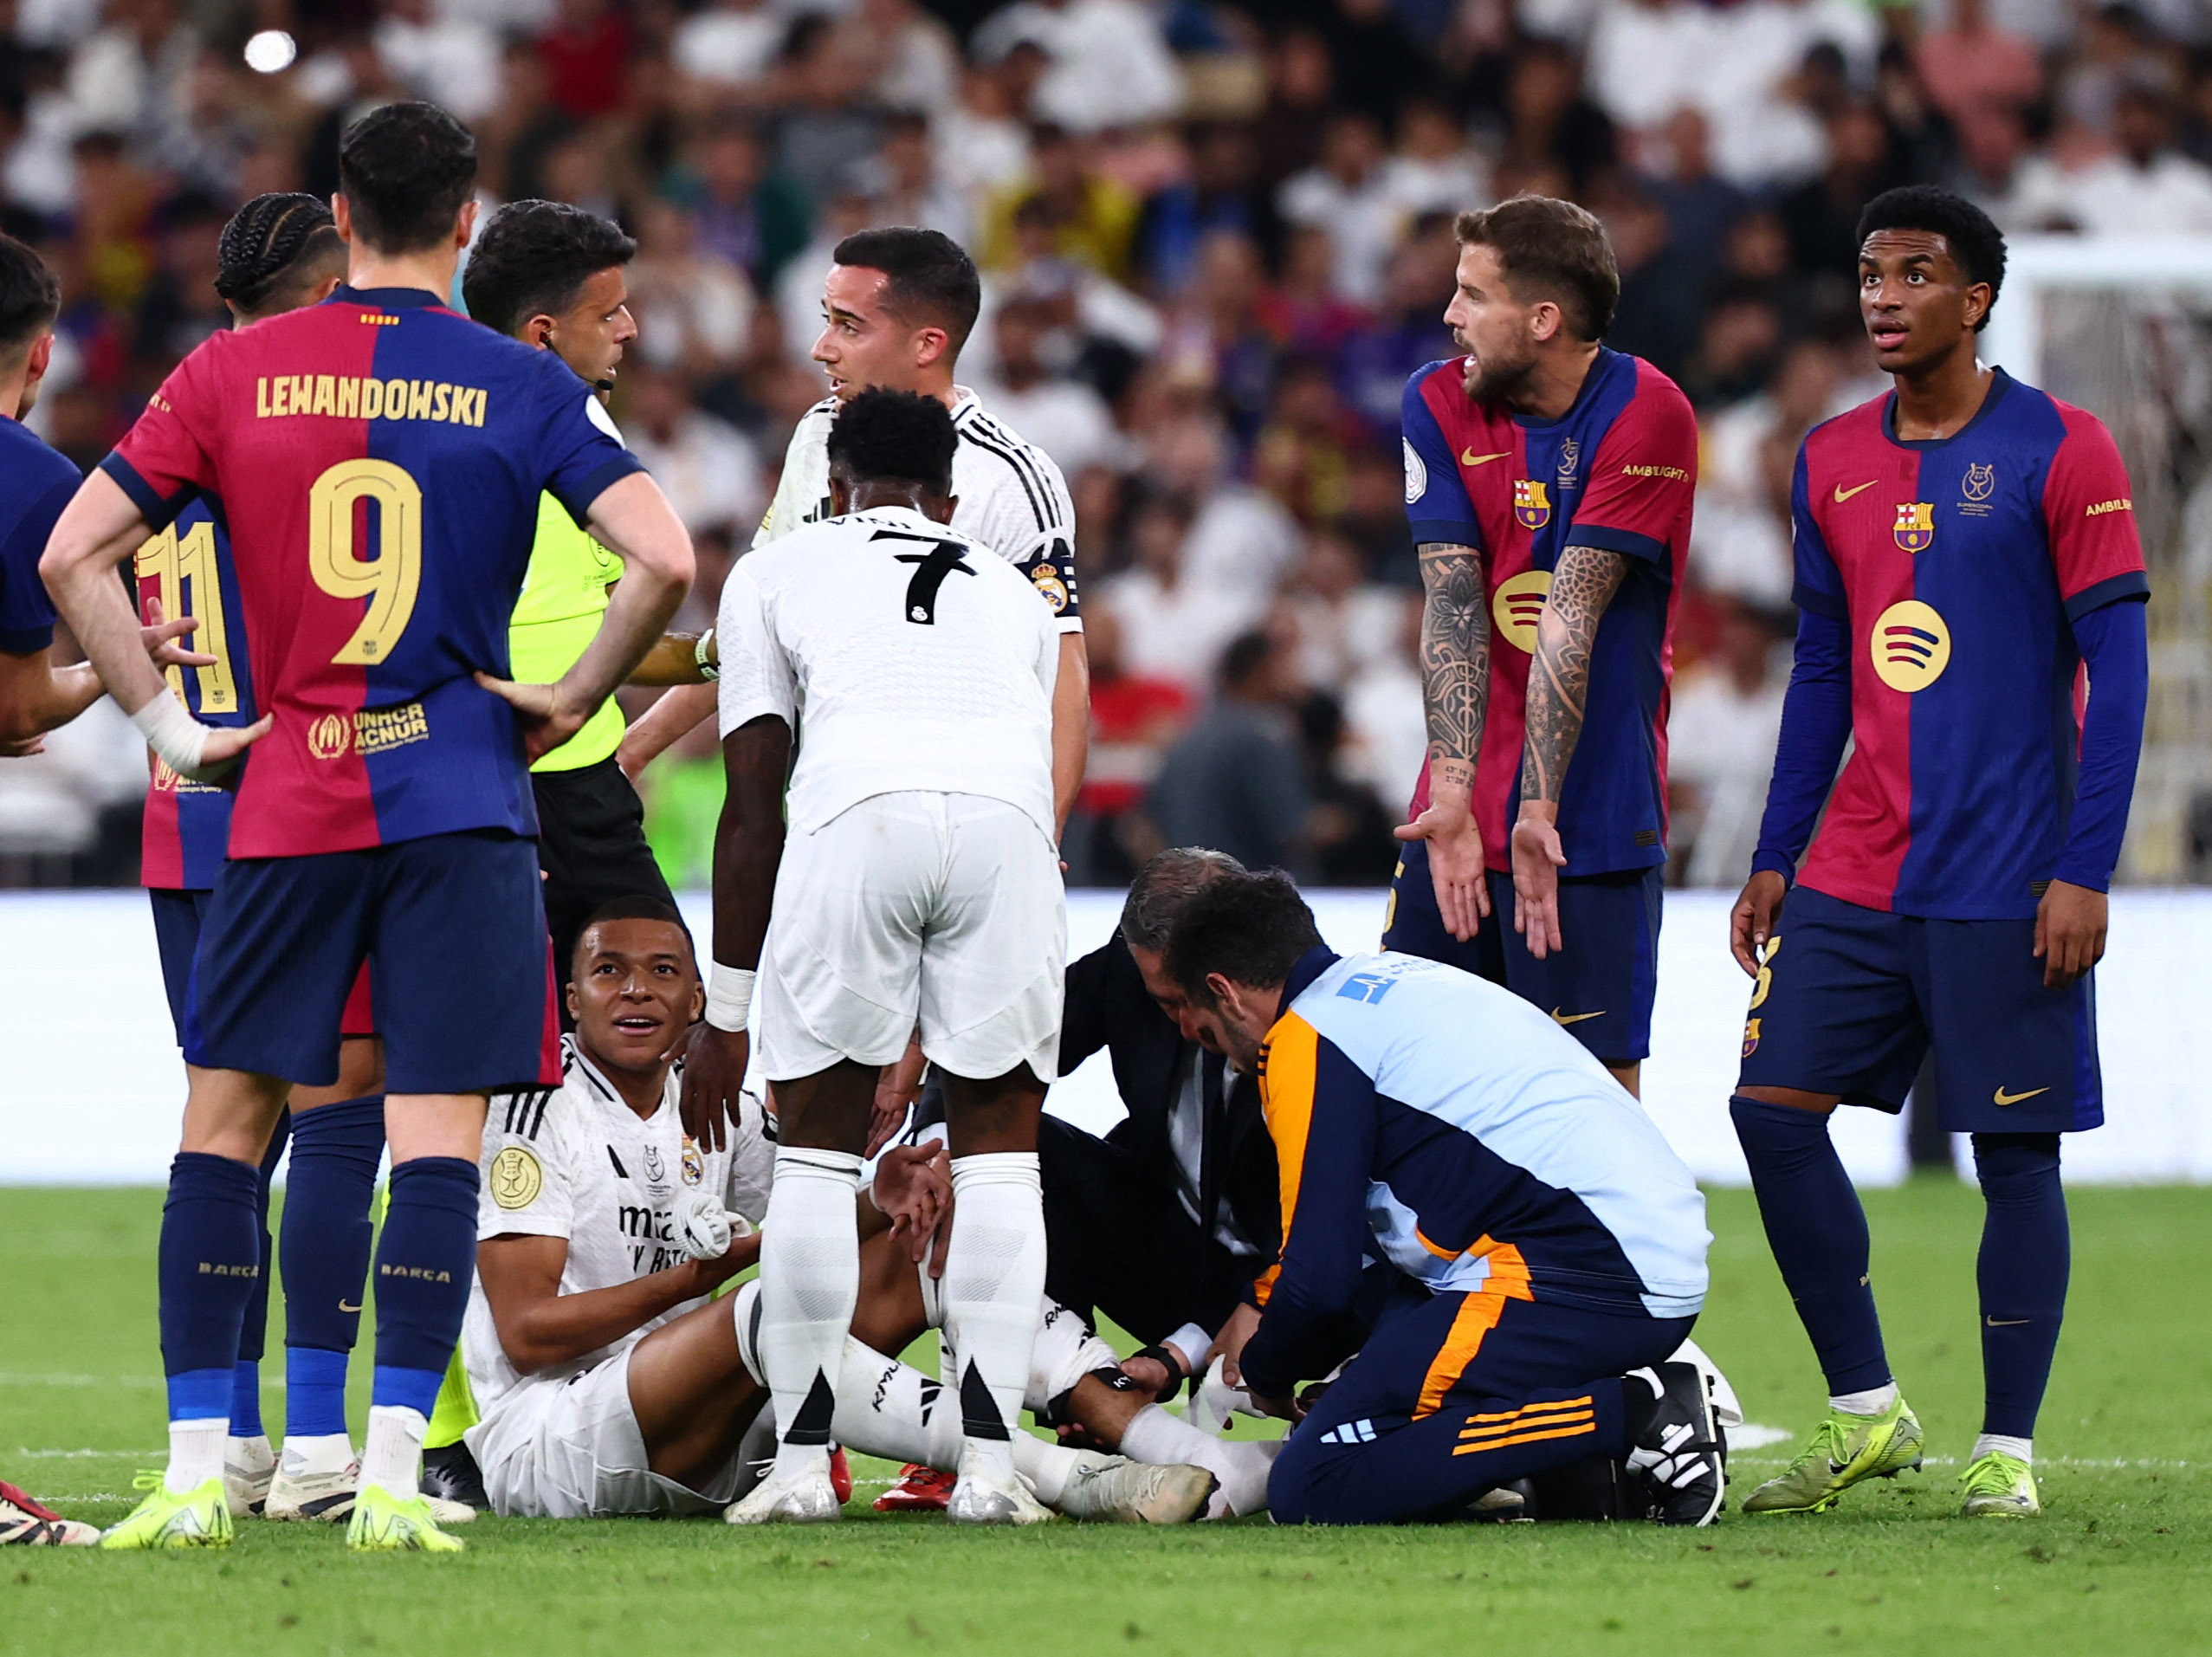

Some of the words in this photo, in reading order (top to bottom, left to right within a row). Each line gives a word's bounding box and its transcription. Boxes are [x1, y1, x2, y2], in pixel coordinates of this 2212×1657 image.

[257, 374, 488, 428] LEWANDOWSKI
[309, 458, 423, 665] 9
[868, 530, 979, 625] 7
[137, 521, 238, 714] 11
[353, 703, 425, 729] UNHCR
[354, 719, 429, 748] ACNUR
